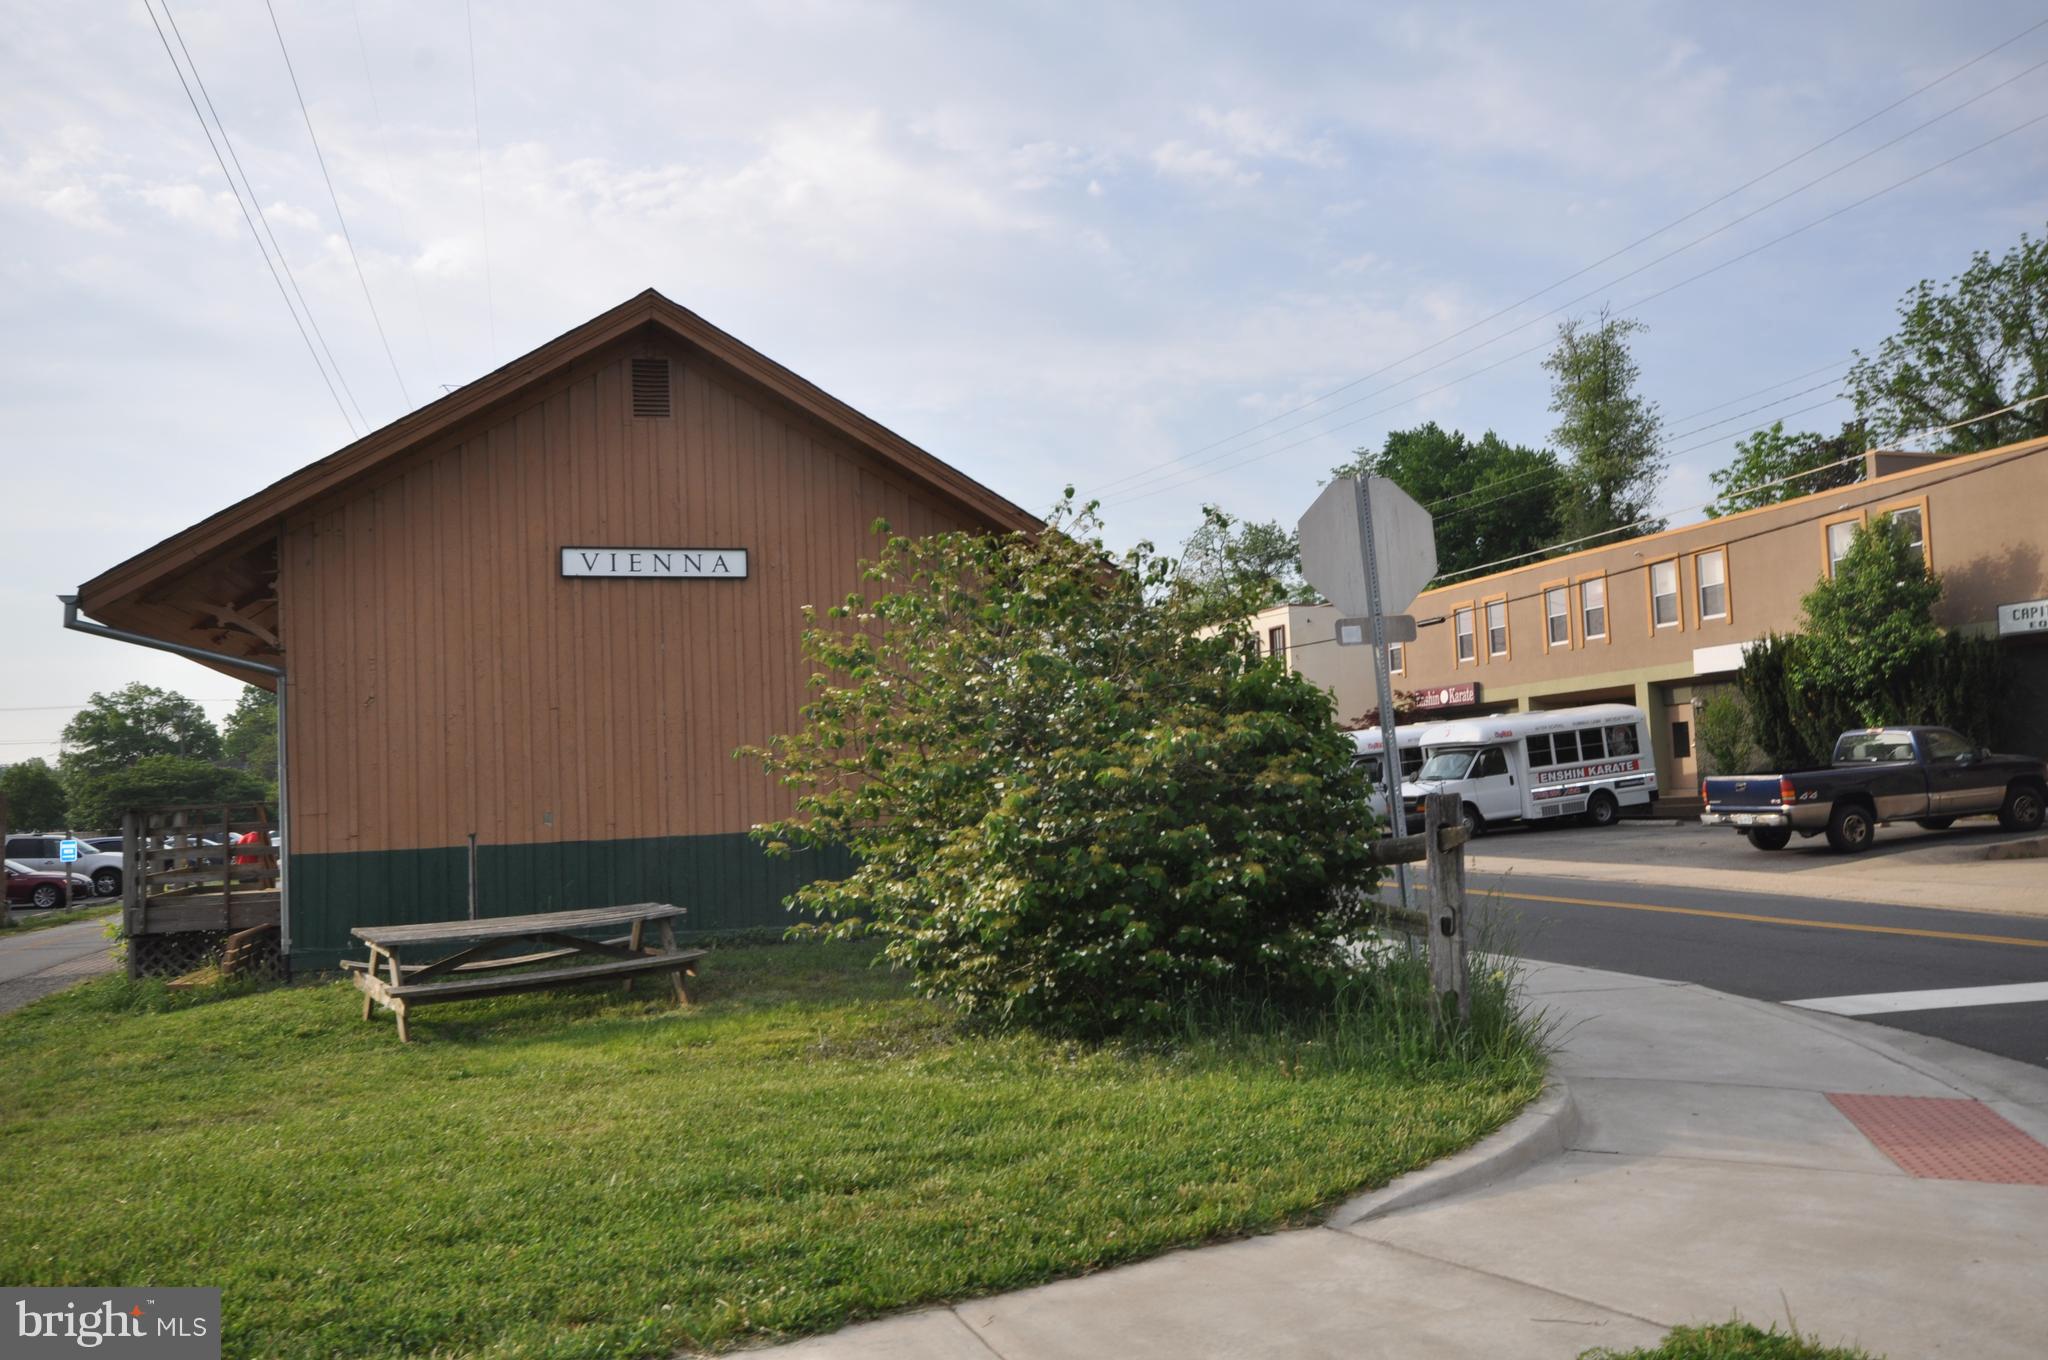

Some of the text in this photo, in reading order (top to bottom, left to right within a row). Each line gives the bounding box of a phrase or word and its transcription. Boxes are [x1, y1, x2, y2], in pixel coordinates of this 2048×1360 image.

[580, 553, 731, 573] VIENNA
[2012, 605, 2048, 620] CAPI
[1448, 687, 1474, 704] Karate
[1540, 761, 1634, 783] ENSHIN KARATE
